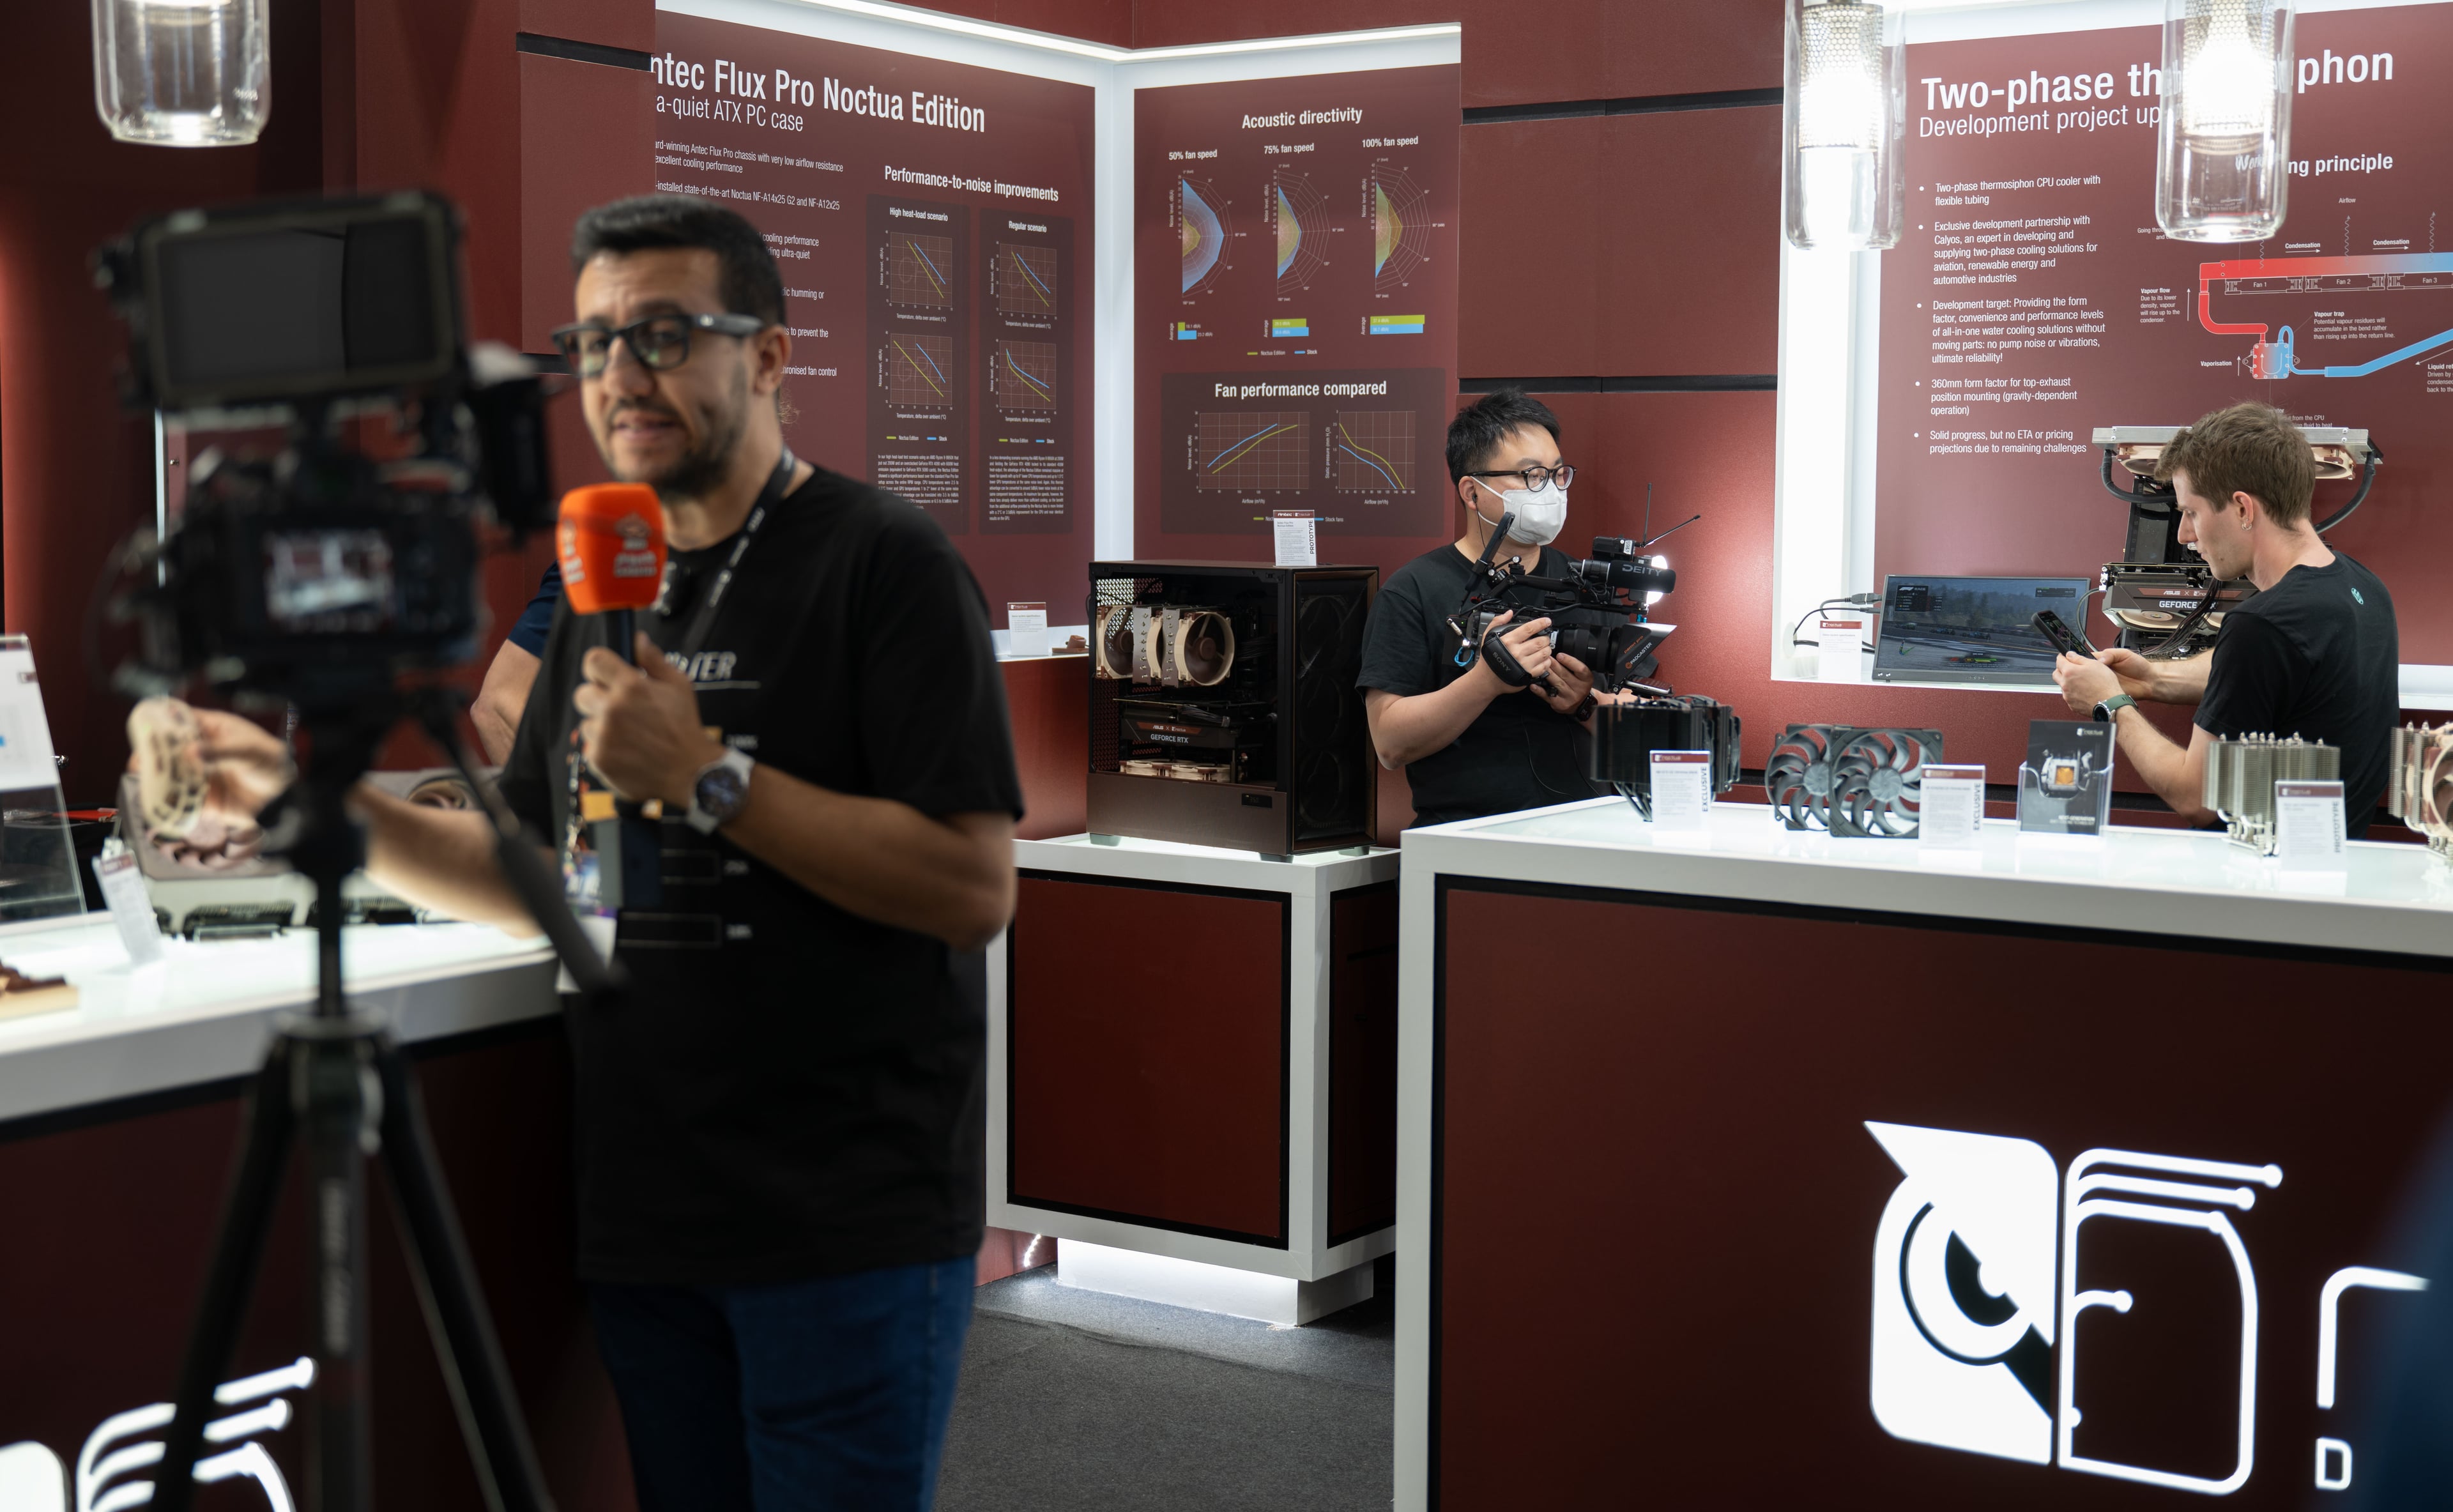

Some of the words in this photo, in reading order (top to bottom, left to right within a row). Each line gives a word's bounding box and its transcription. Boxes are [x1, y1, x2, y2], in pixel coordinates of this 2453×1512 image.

[651, 52, 705, 91] ntec
[715, 59, 766, 100] Flux
[776, 69, 814, 107] Pro
[823, 77, 904, 121] Noctua
[912, 91, 985, 133] Edition
[1921, 70, 2114, 112] Two-phase
[655, 96, 710, 119] a-quiet
[714, 99, 742, 123] ATX
[747, 104, 766, 126] PC
[771, 112, 803, 132] case
[1242, 110, 1295, 129] Acoustic
[1299, 107, 1363, 126] directivity
[1920, 110, 2049, 138] Development
[2057, 104, 2128, 134] project
[1264, 145, 1279, 154] 75%
[1281, 144, 1292, 153] fan
[1294, 142, 1314, 153] speed
[1362, 139, 1382, 148] 100%
[1384, 137, 1395, 146] fan
[1396, 135, 1418, 147] speed
[655, 140, 689, 155] rd-winning
[691, 144, 708, 155] Antec
[710, 146, 722, 157] Flux
[723, 148, 733, 158] Pro
[735, 149, 756, 161] chassis
[758, 153, 770, 162] with
[771, 156, 783, 166] very
[784, 156, 794, 165] low
[795, 158, 814, 168] airflow
[816, 161, 843, 172] resistance
[1169, 151, 1184, 160] 50%
[1185, 151, 1196, 159] fan
[1197, 149, 1217, 160] speed
[655, 155, 682, 165] excellent
[683, 158, 704, 171] cooling
[706, 161, 743, 173] performance
[2315, 153, 2393, 176] principle
[885, 165, 991, 194] Performance-to-noise
[994, 179, 1059, 202] improvements
[1936, 182, 1978, 193] Two-phase
[1980, 179, 2034, 190] thermosiphon
[2037, 177, 2054, 187] CPU
[2056, 176, 2081, 186] cooler
[2083, 174, 2100, 185] with
[684, 185, 730, 197] state-of-the-art
[731, 188, 751, 200] Noctua
[753, 192, 785, 204] NF-A14x25
[787, 195, 795, 205] G2
[797, 197, 807, 206] and
[809, 197, 839, 210] NF-A12x25
[1935, 195, 1962, 206] flexible
[1964, 195, 1989, 205] tubing
[890, 207, 901, 217] High
[903, 209, 926, 219] heat-load
[927, 213, 948, 221] scenario
[1009, 220, 1027, 231] Regular
[1027, 224, 1047, 233] scenario
[1935, 221, 1970, 231] Exclusive
[1973, 218, 2023, 230] development
[2025, 216, 2070, 229] partnership
[2073, 215, 2090, 225] with
[763, 233, 783, 245] cooling
[784, 235, 819, 247] performance
[1934, 235, 1962, 246] Calyos,
[1976, 233, 2001, 244] expert
[2003, 233, 2010, 241] in
[2013, 231, 2056, 242] developing
[2058, 229, 2074, 239] and
[781, 248, 810, 260] ultra-quiet
[1934, 248, 1971, 259] supplying
[1973, 246, 2015, 257] two-phase
[2017, 245, 2045, 256] cooling
[2048, 243, 2084, 253] solutions
[2086, 242, 2098, 252] for
[1934, 261, 1966, 271] aviation,
[1968, 259, 2009, 270] renewable
[2011, 260, 2038, 270] energy
[2040, 257, 2056, 267] and
[1933, 275, 1976, 284] automotive
[1978, 273, 2017, 283] industries
[791, 287, 817, 300] humming
[1933, 300, 1983, 310] Development
[1986, 299, 2011, 310] target:
[2014, 297, 2051, 308] Providing
[2053, 297, 2066, 306] the
[2068, 296, 2087, 305] form
[1933, 314, 1957, 324] factor,
[1959, 312, 2008, 322] convenience
[2010, 312, 2025, 321] and
[2028, 310, 2078, 322] performance
[2081, 309, 2104, 319] levels
[790, 327, 797, 335] to
[798, 328, 818, 337] prevent
[820, 328, 829, 337] the
[808, 366, 816, 375] fan
[818, 367, 837, 376] control
[1931, 379, 1962, 388] 360mm
[1964, 378, 1982, 387] form
[1985, 378, 2008, 387] factor
[2010, 378, 2021, 386] for
[2023, 377, 2071, 388] top-exhaust
[1215, 383, 1237, 398] Fan
[1241, 383, 1320, 400] performance
[1324, 381, 1387, 399] compared
[1931, 392, 1961, 403] position
[1964, 392, 2000, 402] mounting
[2003, 390, 2077, 402] (gravity-dependent
[1930, 405, 1969, 416] operation)
[1930, 431, 1949, 439] Solid
[1952, 432, 1987, 441] progress,
[1990, 430, 2003, 439] but
[2017, 429, 2033, 439] ETA
[2045, 429, 2073, 441] pricing
[1930, 444, 1972, 454] projections
[1975, 443, 1989, 453] due
[1991, 444, 1999, 452] to
[2002, 443, 2041, 454] remaining
[2044, 443, 2086, 454] challenges
[1623, 564, 1662, 576] DEITY
[1630, 641, 1653, 664] PADCASTER
[1492, 652, 1511, 671] SONY
[1150, 734, 1176, 742] GEFORCE
